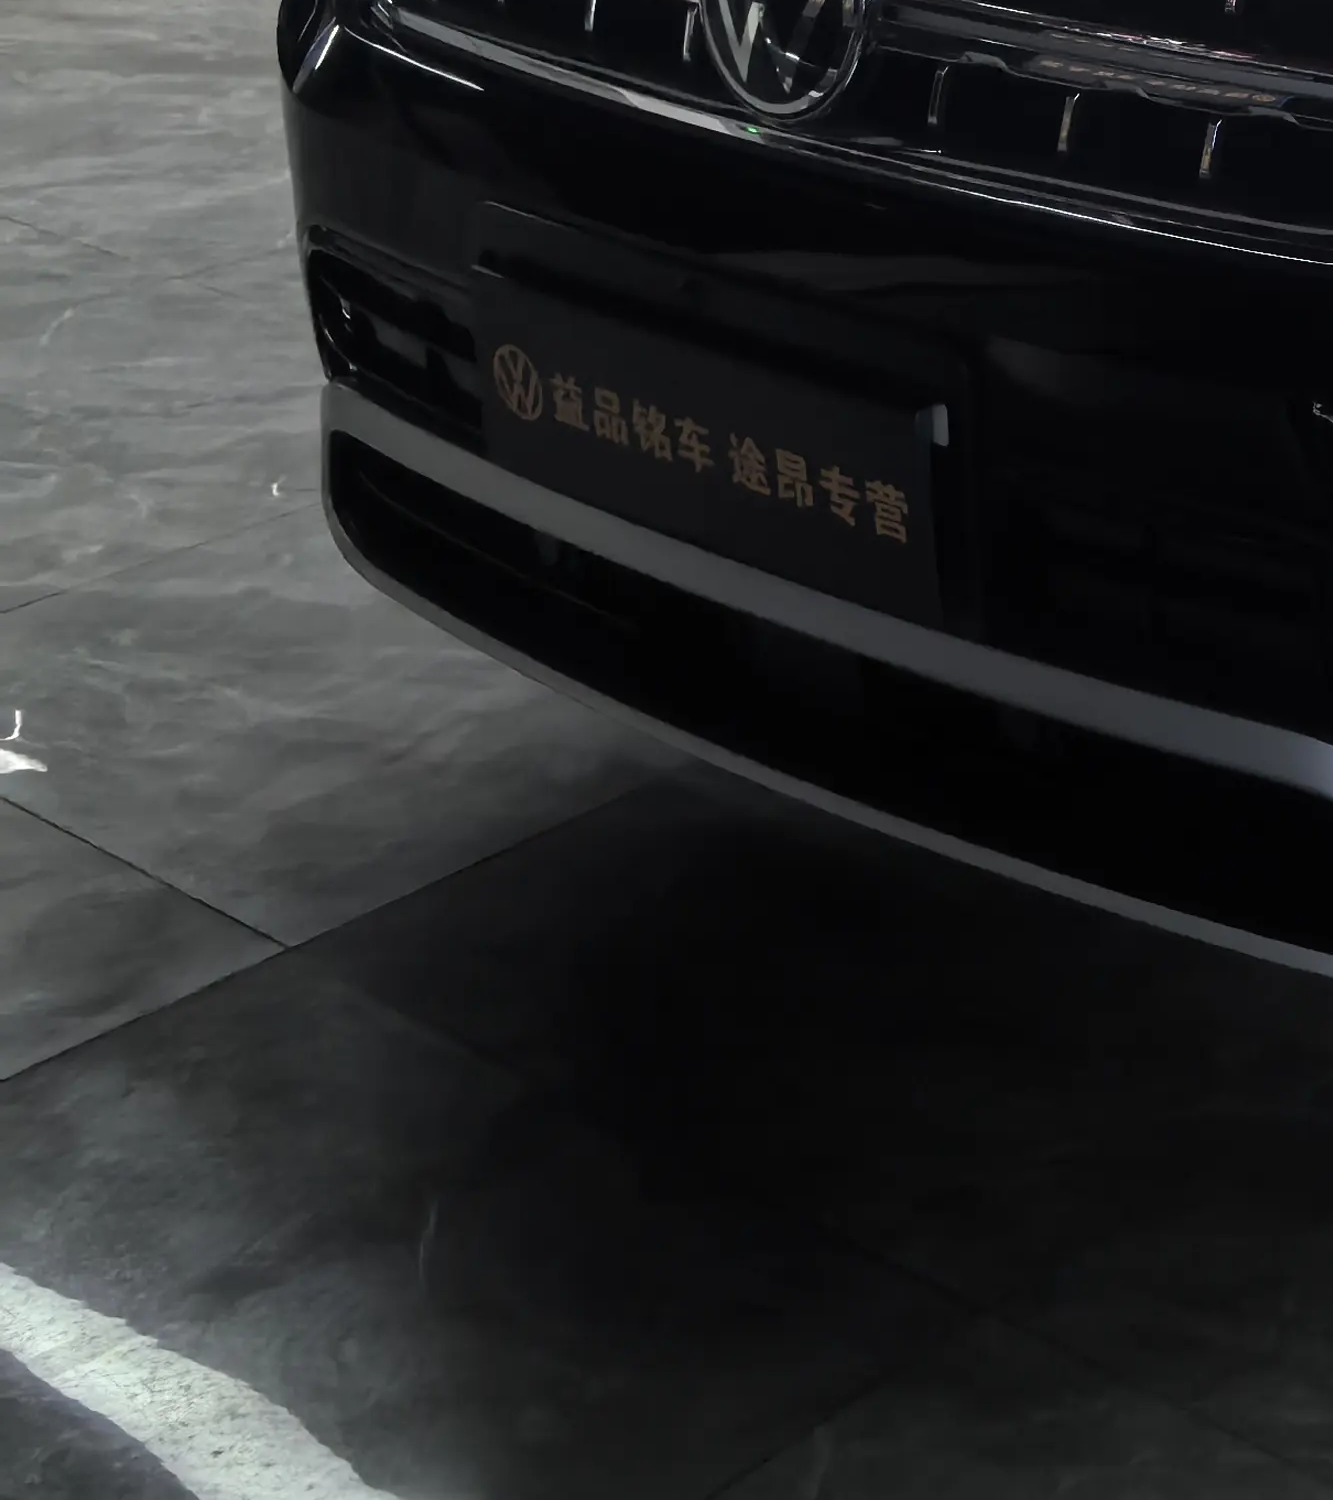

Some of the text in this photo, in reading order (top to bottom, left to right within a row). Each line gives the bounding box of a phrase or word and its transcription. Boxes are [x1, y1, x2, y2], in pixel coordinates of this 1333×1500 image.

[549, 372, 715, 473] 益品铭车
[728, 432, 909, 544] 途昂专营
